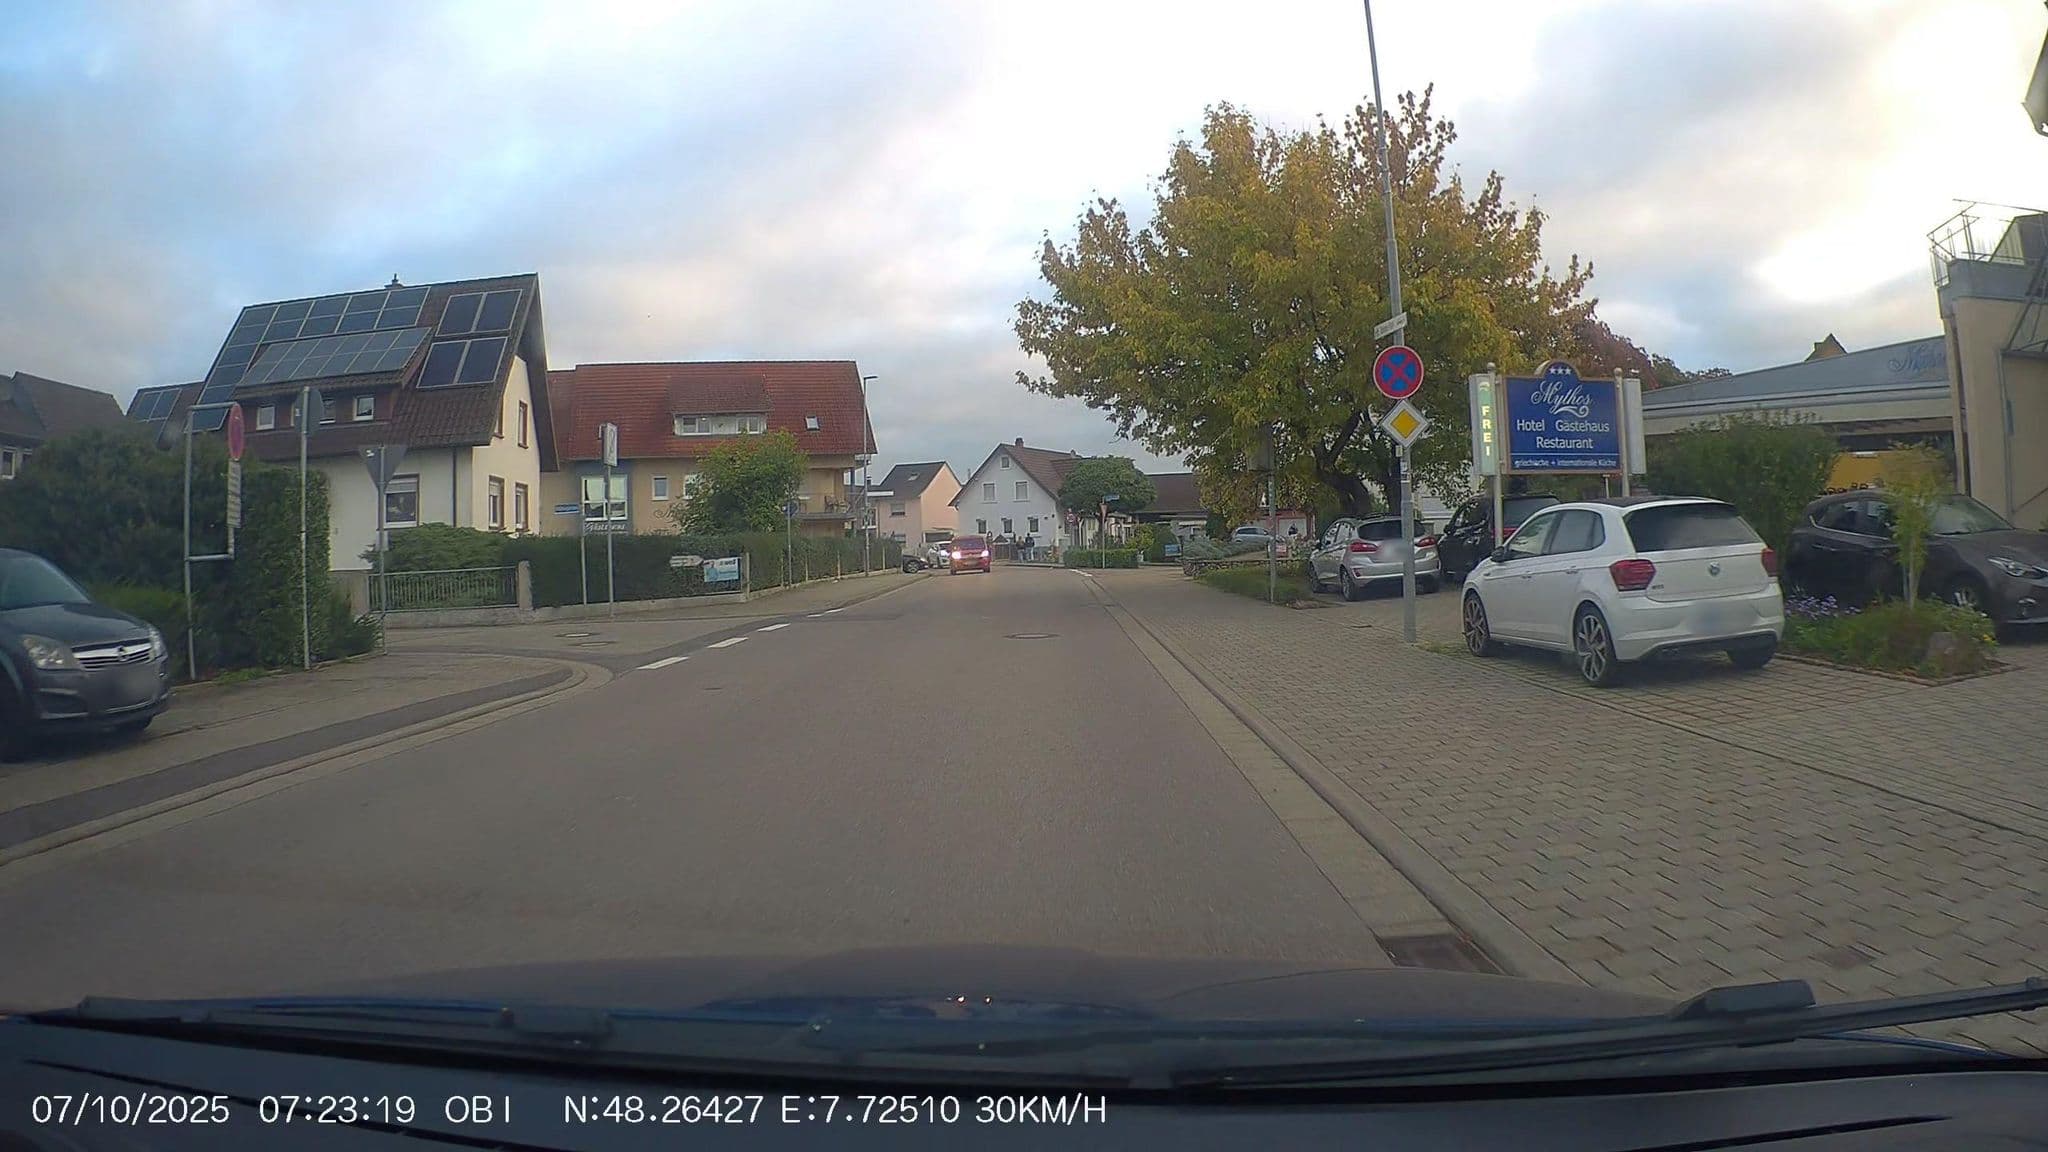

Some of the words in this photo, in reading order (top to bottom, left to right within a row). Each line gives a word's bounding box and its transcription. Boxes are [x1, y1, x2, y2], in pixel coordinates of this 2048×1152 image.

[1531, 380, 1592, 417] Mythos
[1480, 405, 1493, 457] FREI
[1516, 419, 1545, 432] Hotel
[1555, 419, 1610, 432] Gästehaus
[1536, 437, 1594, 449] Restaurant
